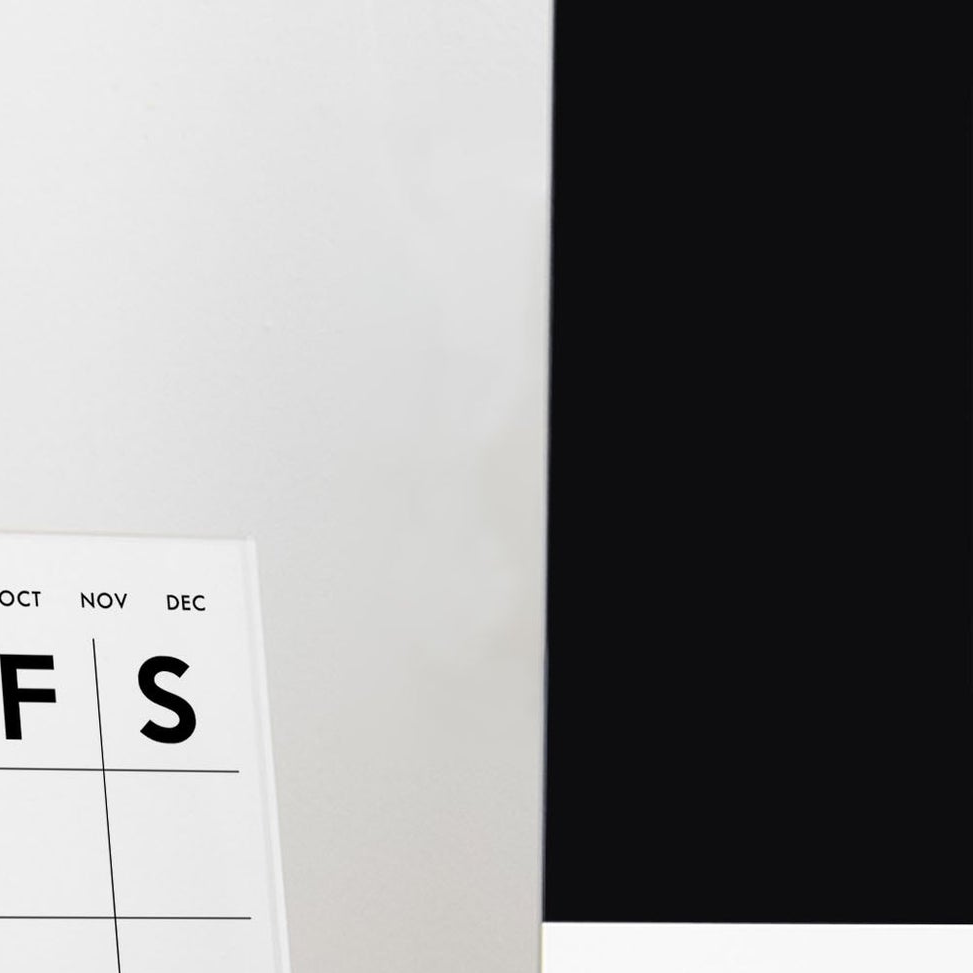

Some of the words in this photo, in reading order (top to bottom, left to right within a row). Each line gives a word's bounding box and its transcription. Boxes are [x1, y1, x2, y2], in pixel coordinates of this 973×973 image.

[80, 592, 128, 610] NOV
[166, 594, 206, 612] DEC
[0, 654, 56, 740] F
[138, 656, 196, 744] S
